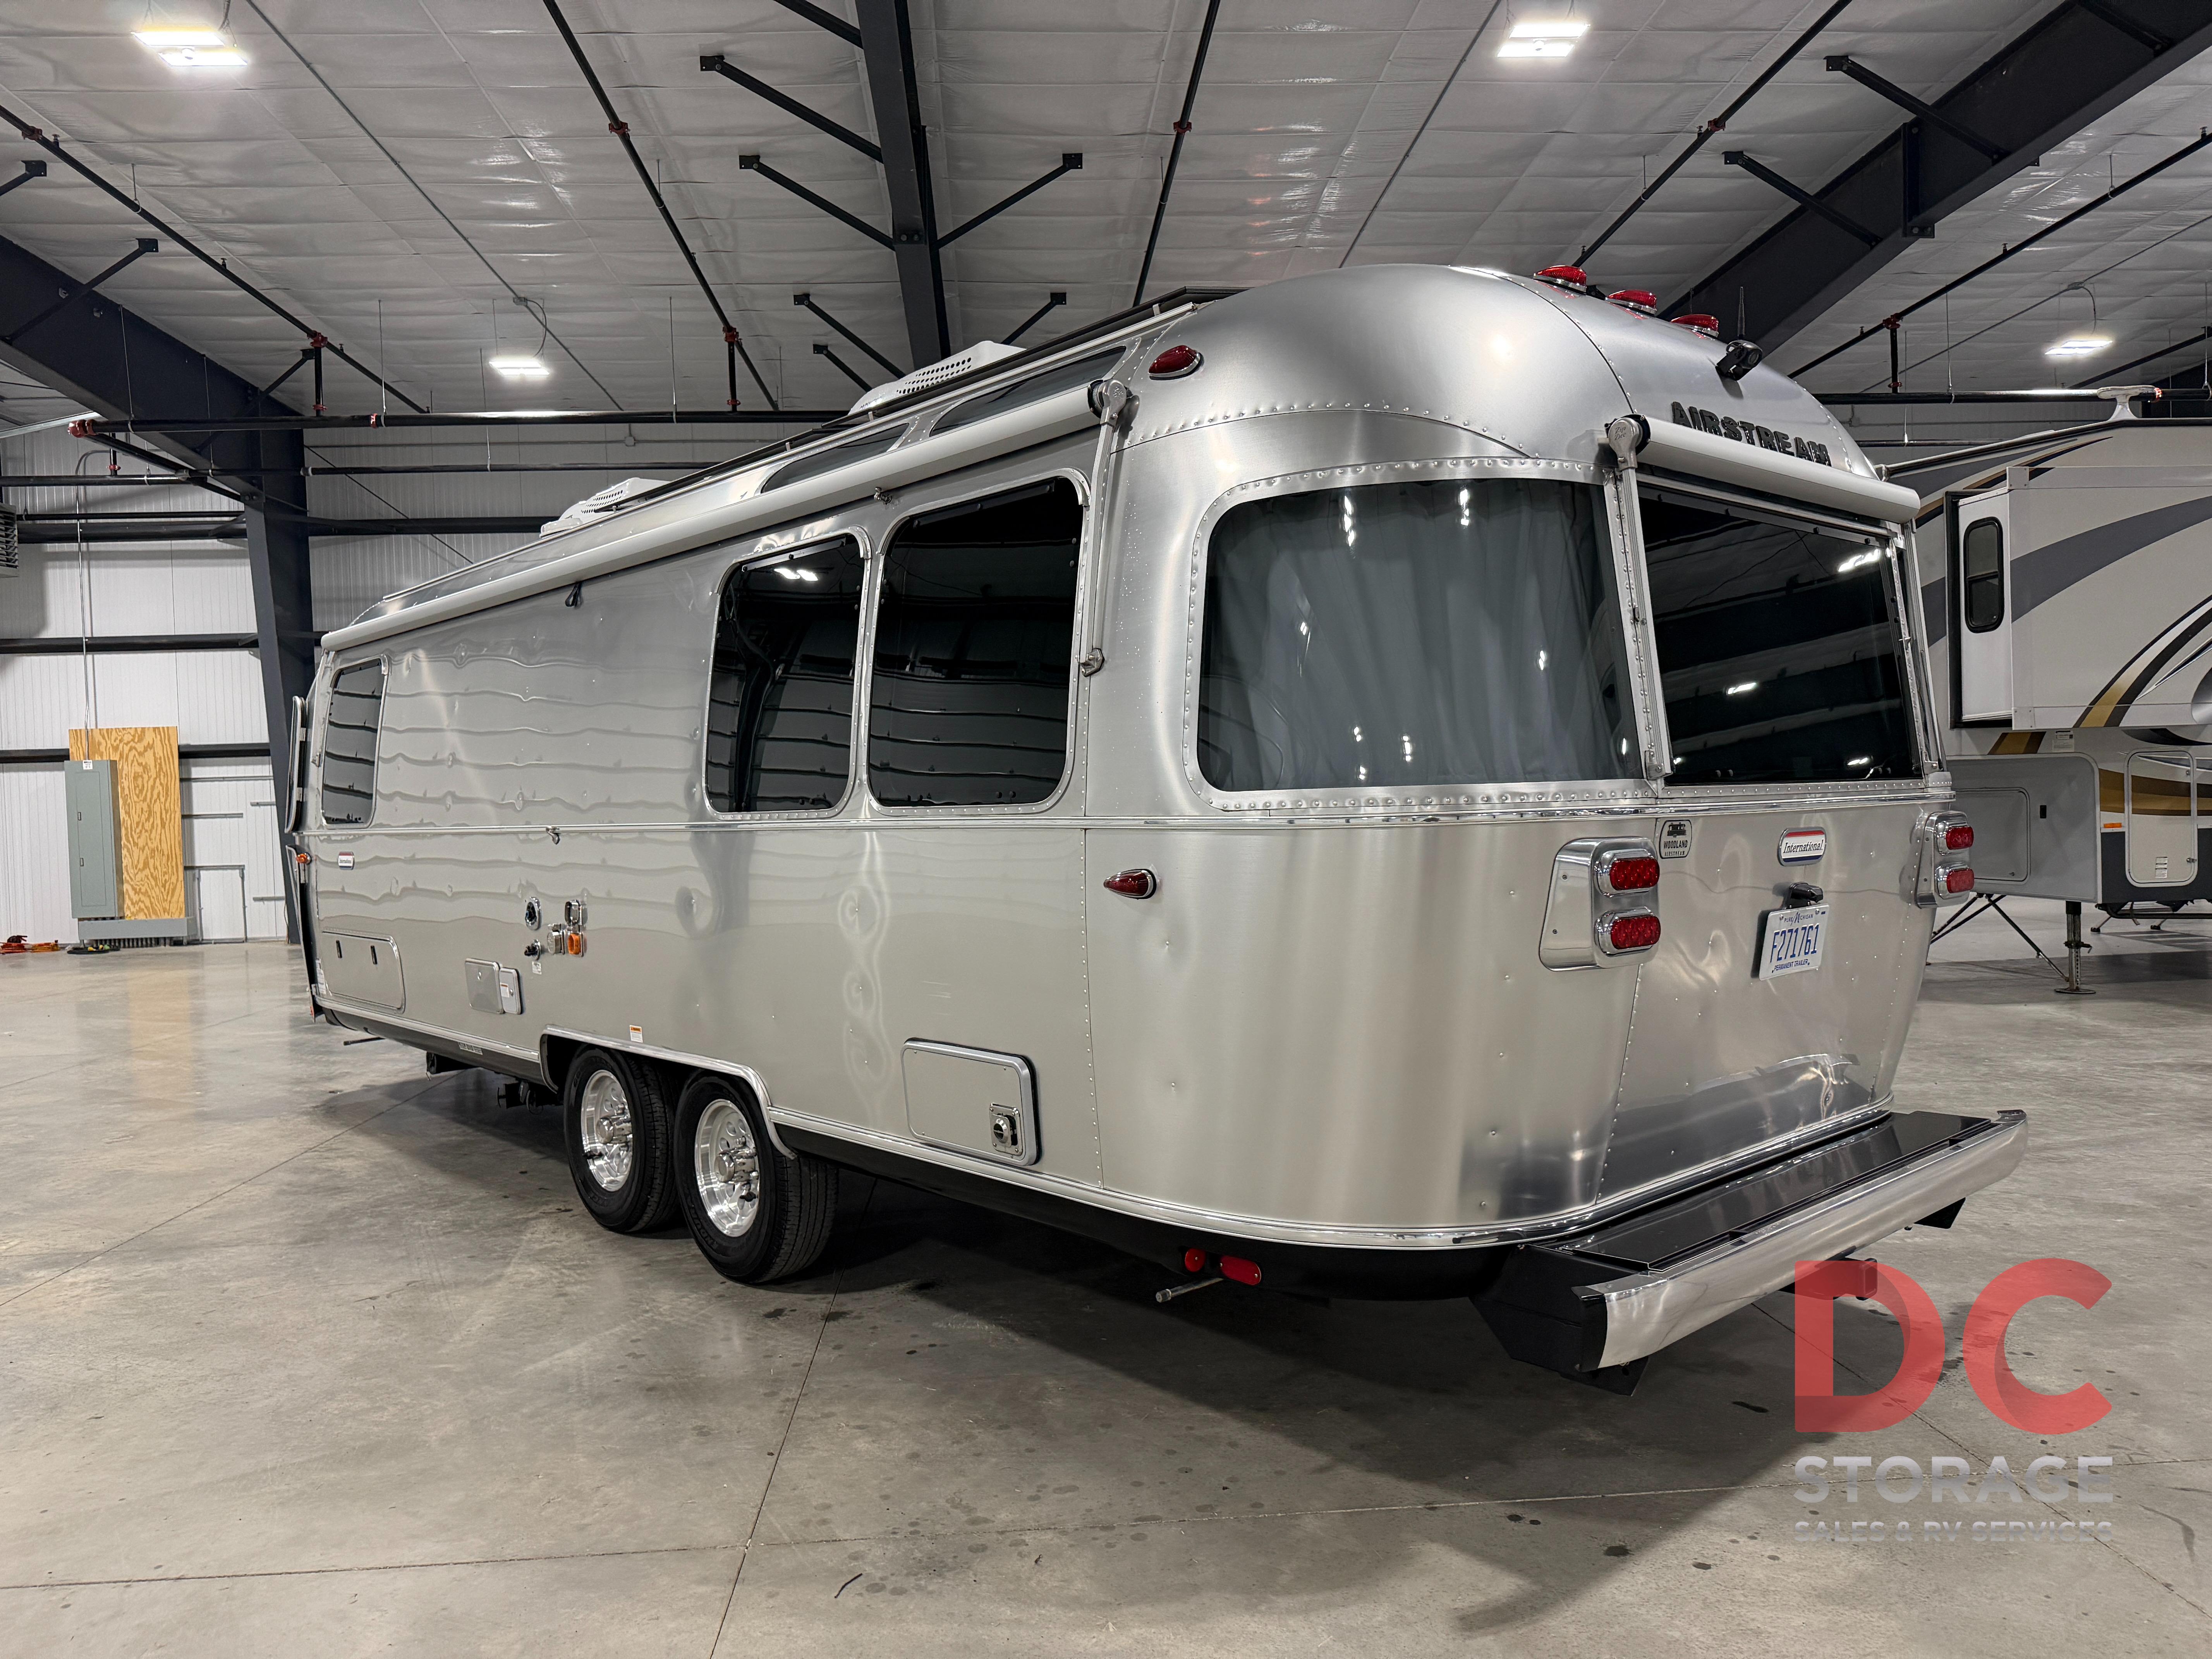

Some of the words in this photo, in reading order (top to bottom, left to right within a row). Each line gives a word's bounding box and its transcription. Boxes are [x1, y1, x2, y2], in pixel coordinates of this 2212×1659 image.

[1671, 401, 1832, 467] AIRSTREAM
[1664, 840, 1688, 849] WOODLAND
[1783, 839, 1824, 853] International
[1770, 924, 1819, 963] F271761
[1794, 959, 1808, 967] TRAILER
